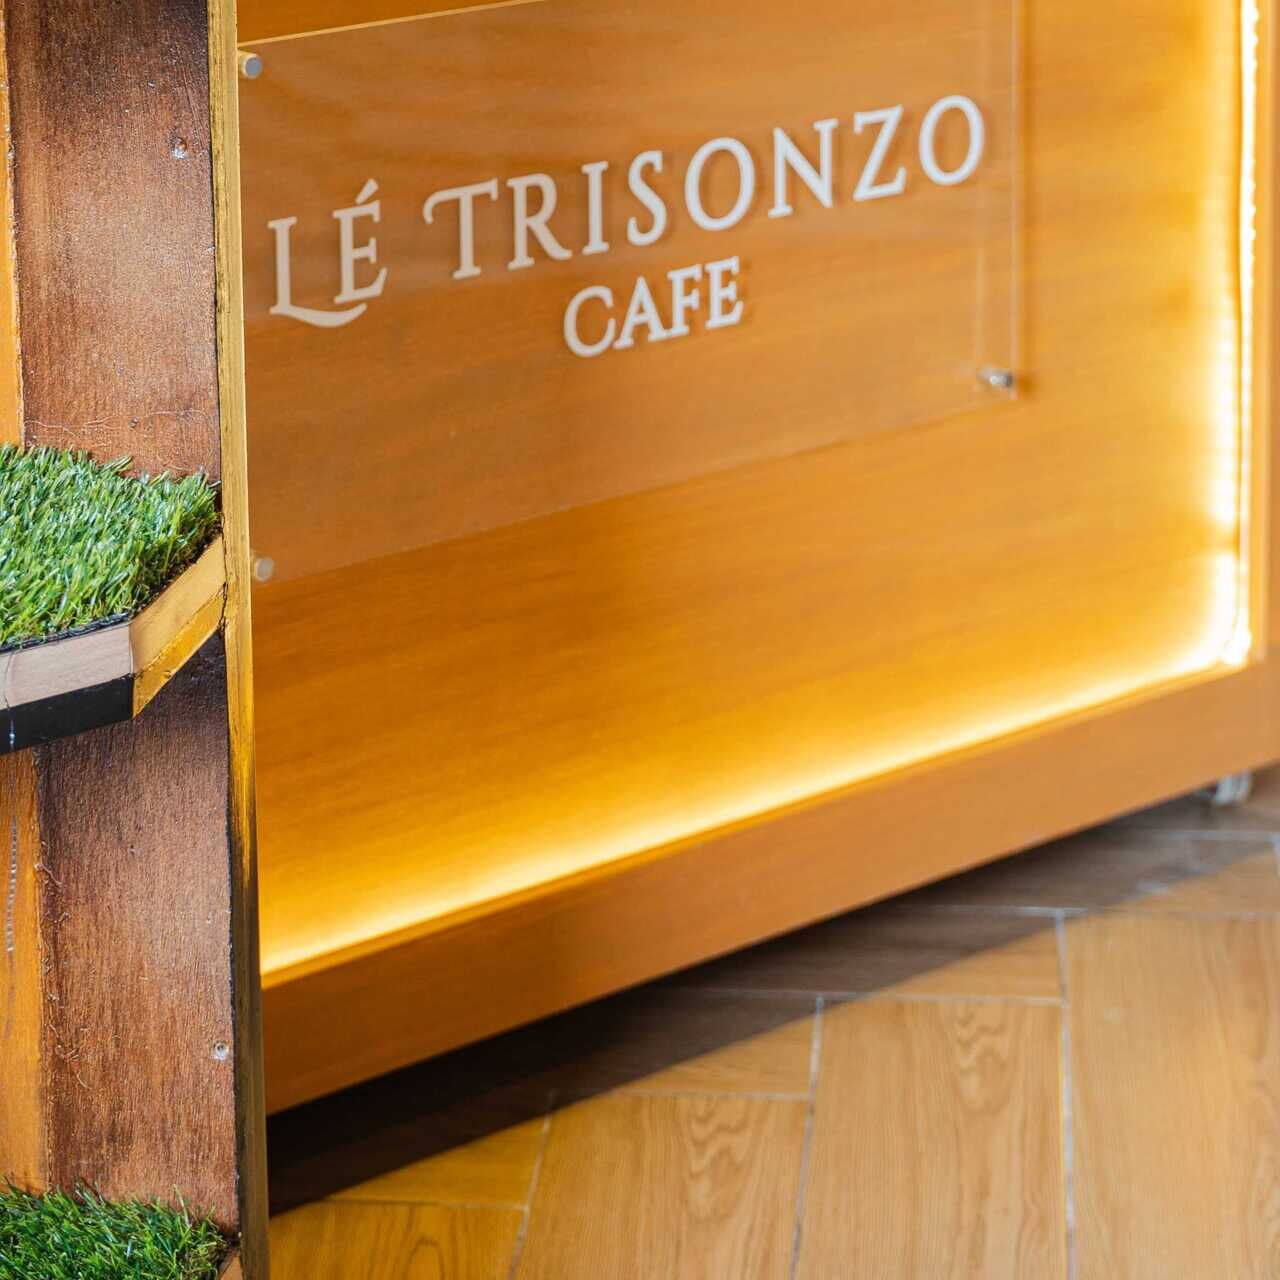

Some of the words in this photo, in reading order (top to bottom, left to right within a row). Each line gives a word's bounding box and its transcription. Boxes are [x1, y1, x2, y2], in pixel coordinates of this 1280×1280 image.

[268, 178, 388, 327] LÉ
[424, 95, 986, 280] TRISONZO
[564, 256, 744, 358] CAFE
